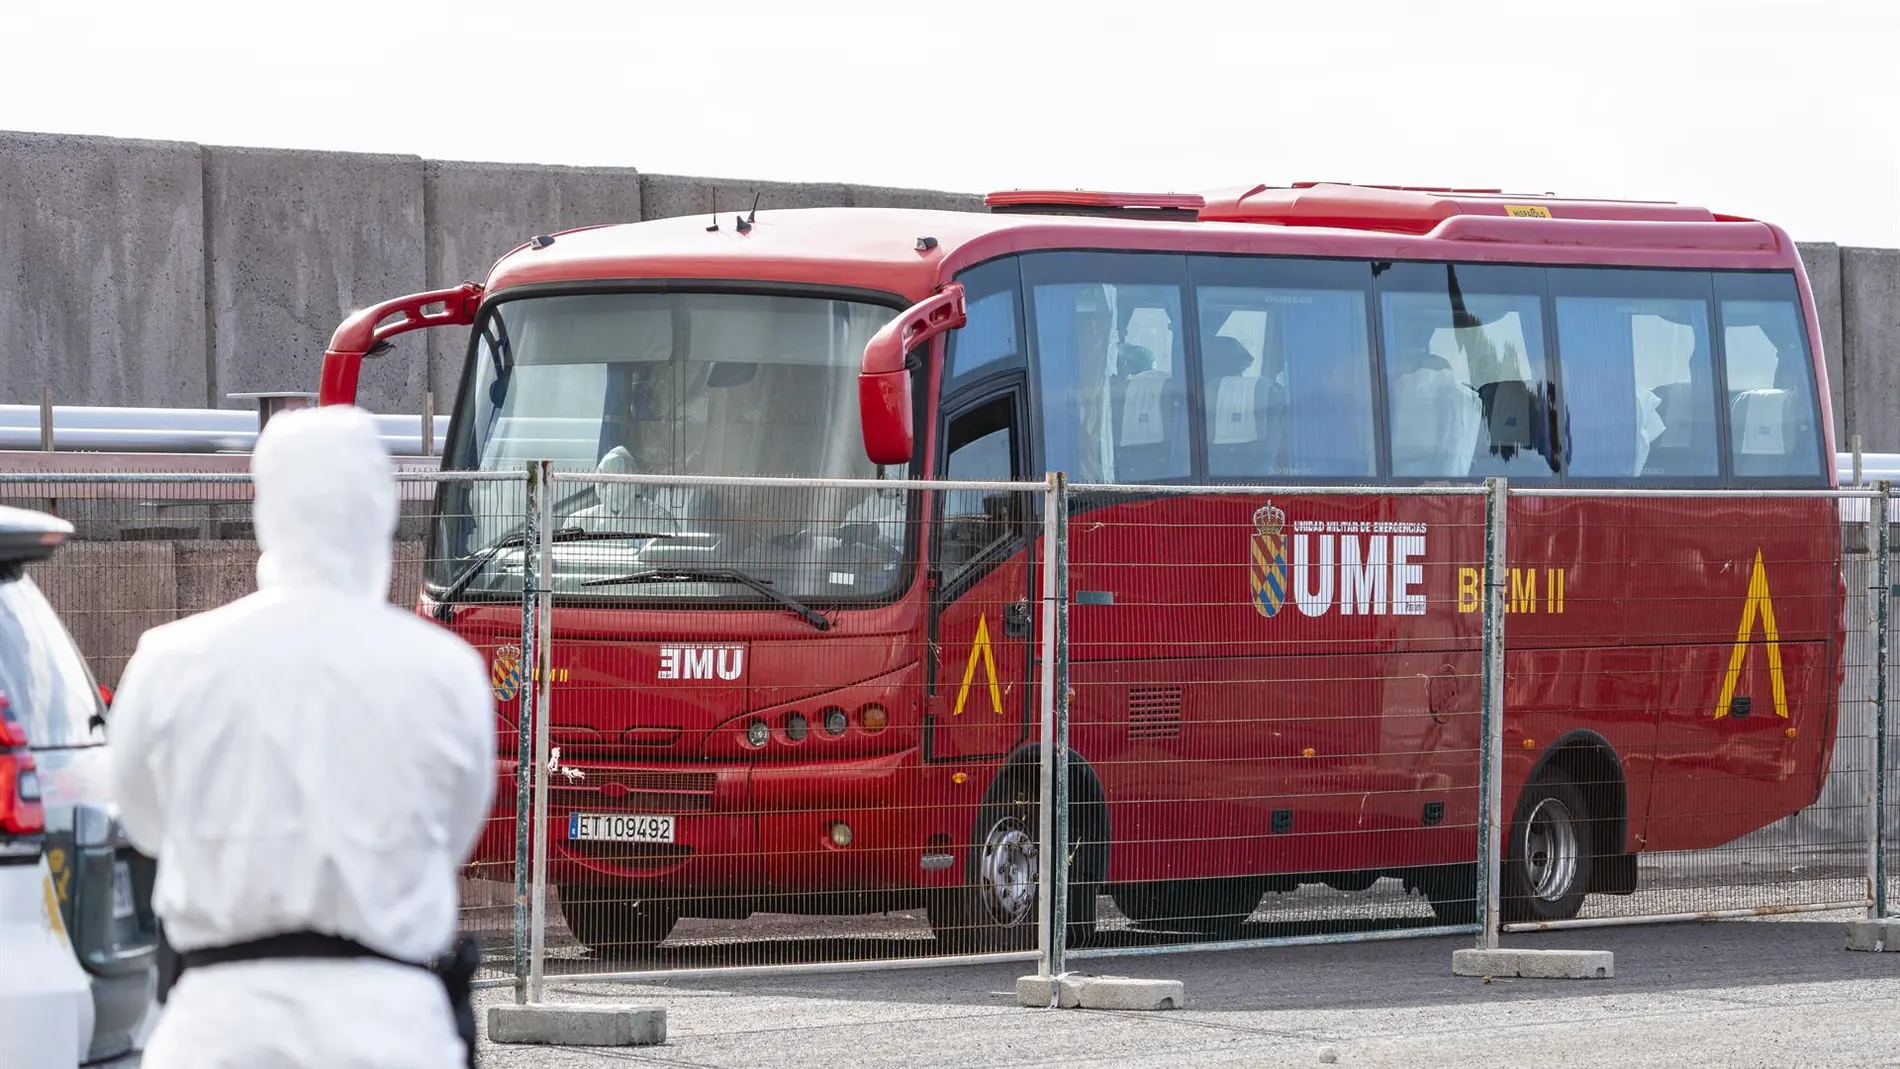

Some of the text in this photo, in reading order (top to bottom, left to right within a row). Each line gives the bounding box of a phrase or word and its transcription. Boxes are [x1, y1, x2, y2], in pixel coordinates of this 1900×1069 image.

[1294, 520, 1427, 533] UNIDAD MILITAR DE EMERGENCIAS
[1293, 534, 1427, 617] UME
